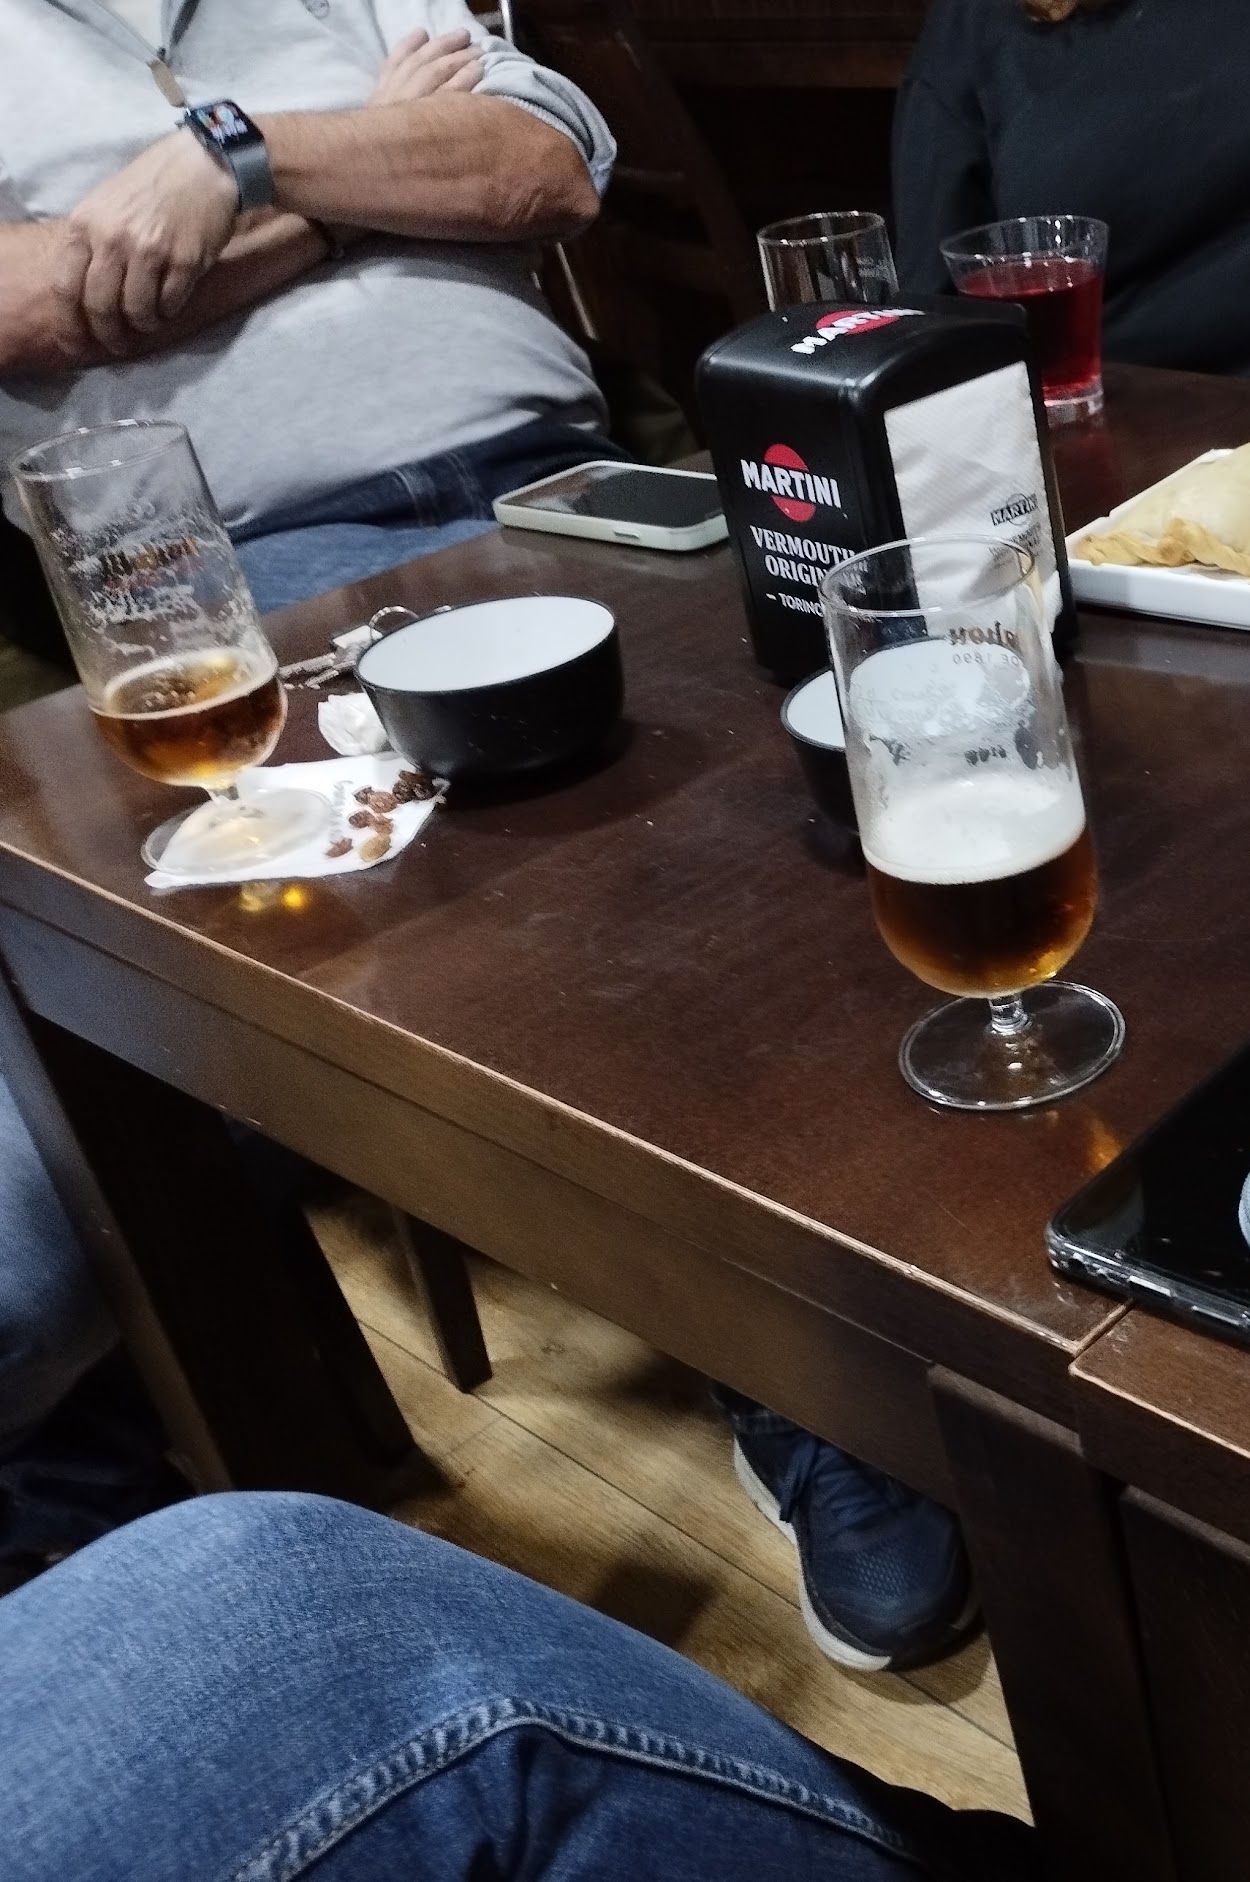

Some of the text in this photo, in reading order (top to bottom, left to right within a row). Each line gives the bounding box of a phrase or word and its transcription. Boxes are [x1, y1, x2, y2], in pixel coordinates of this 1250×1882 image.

[740, 459, 842, 509] MARTINI
[990, 493, 1039, 526] MARTIN
[764, 554, 830, 588] ORIGIN
